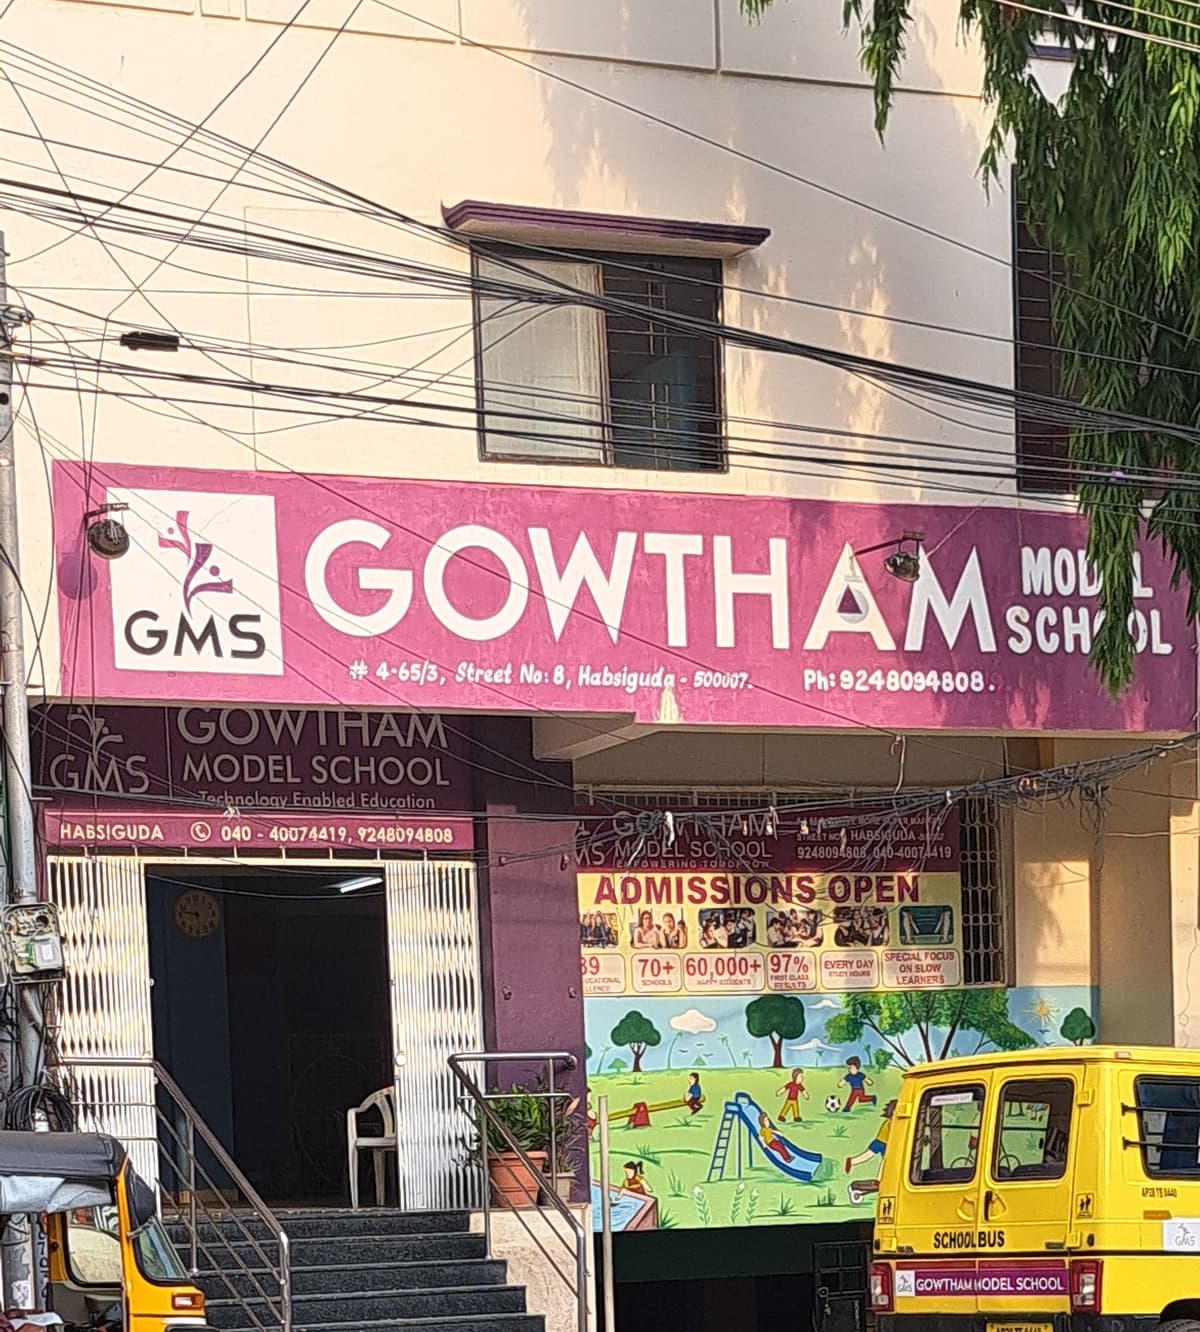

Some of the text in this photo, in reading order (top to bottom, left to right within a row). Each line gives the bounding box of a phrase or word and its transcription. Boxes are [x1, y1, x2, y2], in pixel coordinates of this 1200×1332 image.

[1021, 546, 1154, 598] MODL
[304, 519, 997, 653] GOWTHAM
[124, 610, 266, 659] GMS
[376, 661, 446, 685] 4-65/3,
[455, 661, 511, 684] Street
[578, 665, 674, 694] Habsiguda
[177, 707, 449, 749] GOWTHAM
[50, 754, 150, 794] GMS
[183, 753, 450, 786] MODEL SCHOOL
[199, 790, 435, 809] Technology Enabled Education
[60, 824, 164, 841] HABSIGUDA
[220, 826, 251, 842] 040
[269, 827, 352, 844] 40074419,
[357, 827, 453, 843] 9248094808
[690, 841, 773, 858] SCHOOL
[594, 876, 920, 905] ADMISSIONS OPEN
[770, 954, 809, 973] 97%
[824, 959, 873, 970] EVERY DAY
[884, 951, 955, 962] SPECIAL FOCUS
[638, 958, 675, 978] 70+
[686, 957, 761, 980] 60,000+
[899, 963, 941, 973] ON SLOW
[896, 974, 944, 985] LEARNERS
[933, 1230, 1005, 1249] SCHOOL BUS
[916, 1278, 972, 1291] GOWTHAM
[1015, 1277, 1065, 1291] SCHOOL
